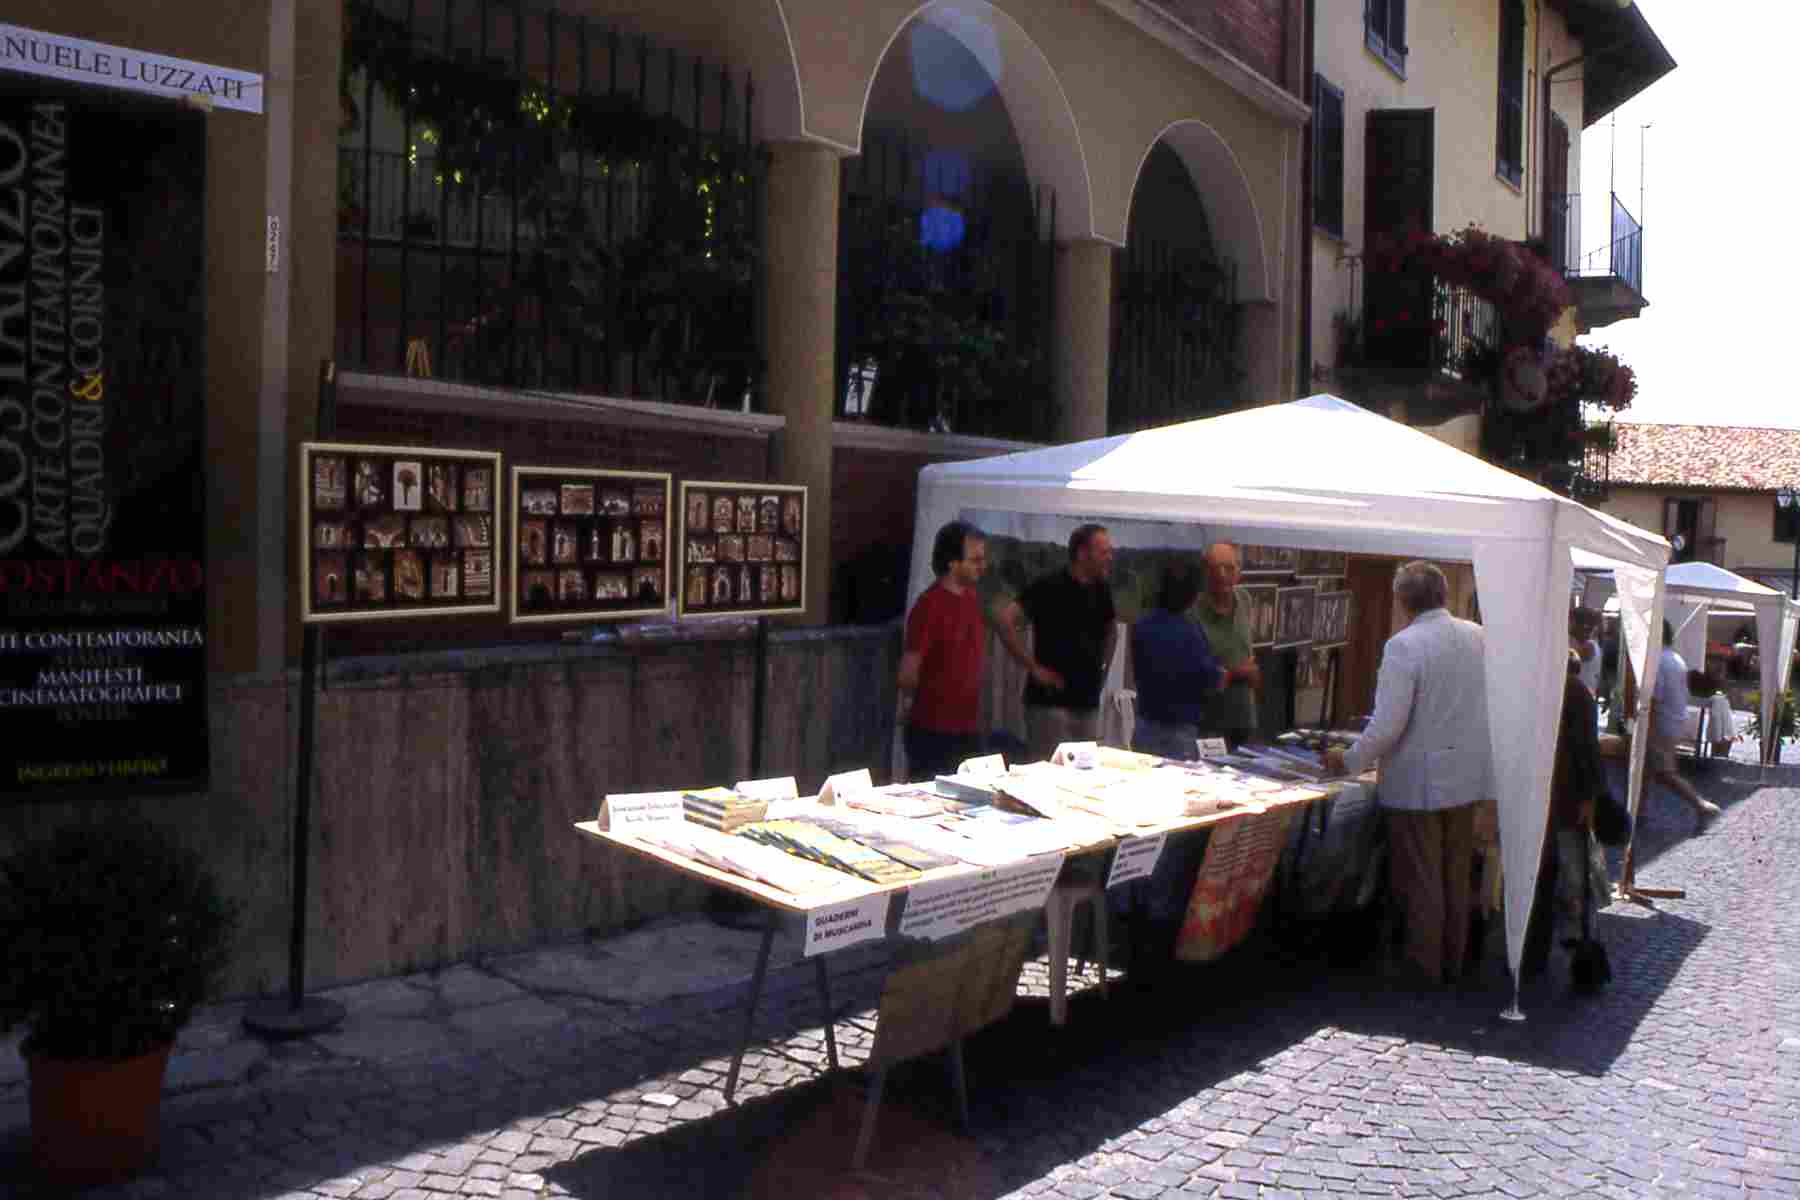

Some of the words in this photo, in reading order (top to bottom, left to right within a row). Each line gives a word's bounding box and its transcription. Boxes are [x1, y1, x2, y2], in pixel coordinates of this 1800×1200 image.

[0, 34, 112, 75] NUELE
[119, 57, 243, 99] LUZZATI
[32, 101, 66, 449] CONTEMPORANEA
[70, 206, 105, 368] CORNICI
[70, 370, 104, 401] &
[32, 457, 66, 554] ARTE
[70, 402, 112, 555] QUADRI
[25, 628, 204, 649] CONTEMPORANEA
[38, 667, 143, 686] MANIFESTI
[815, 907, 859, 927] QUADERNI
